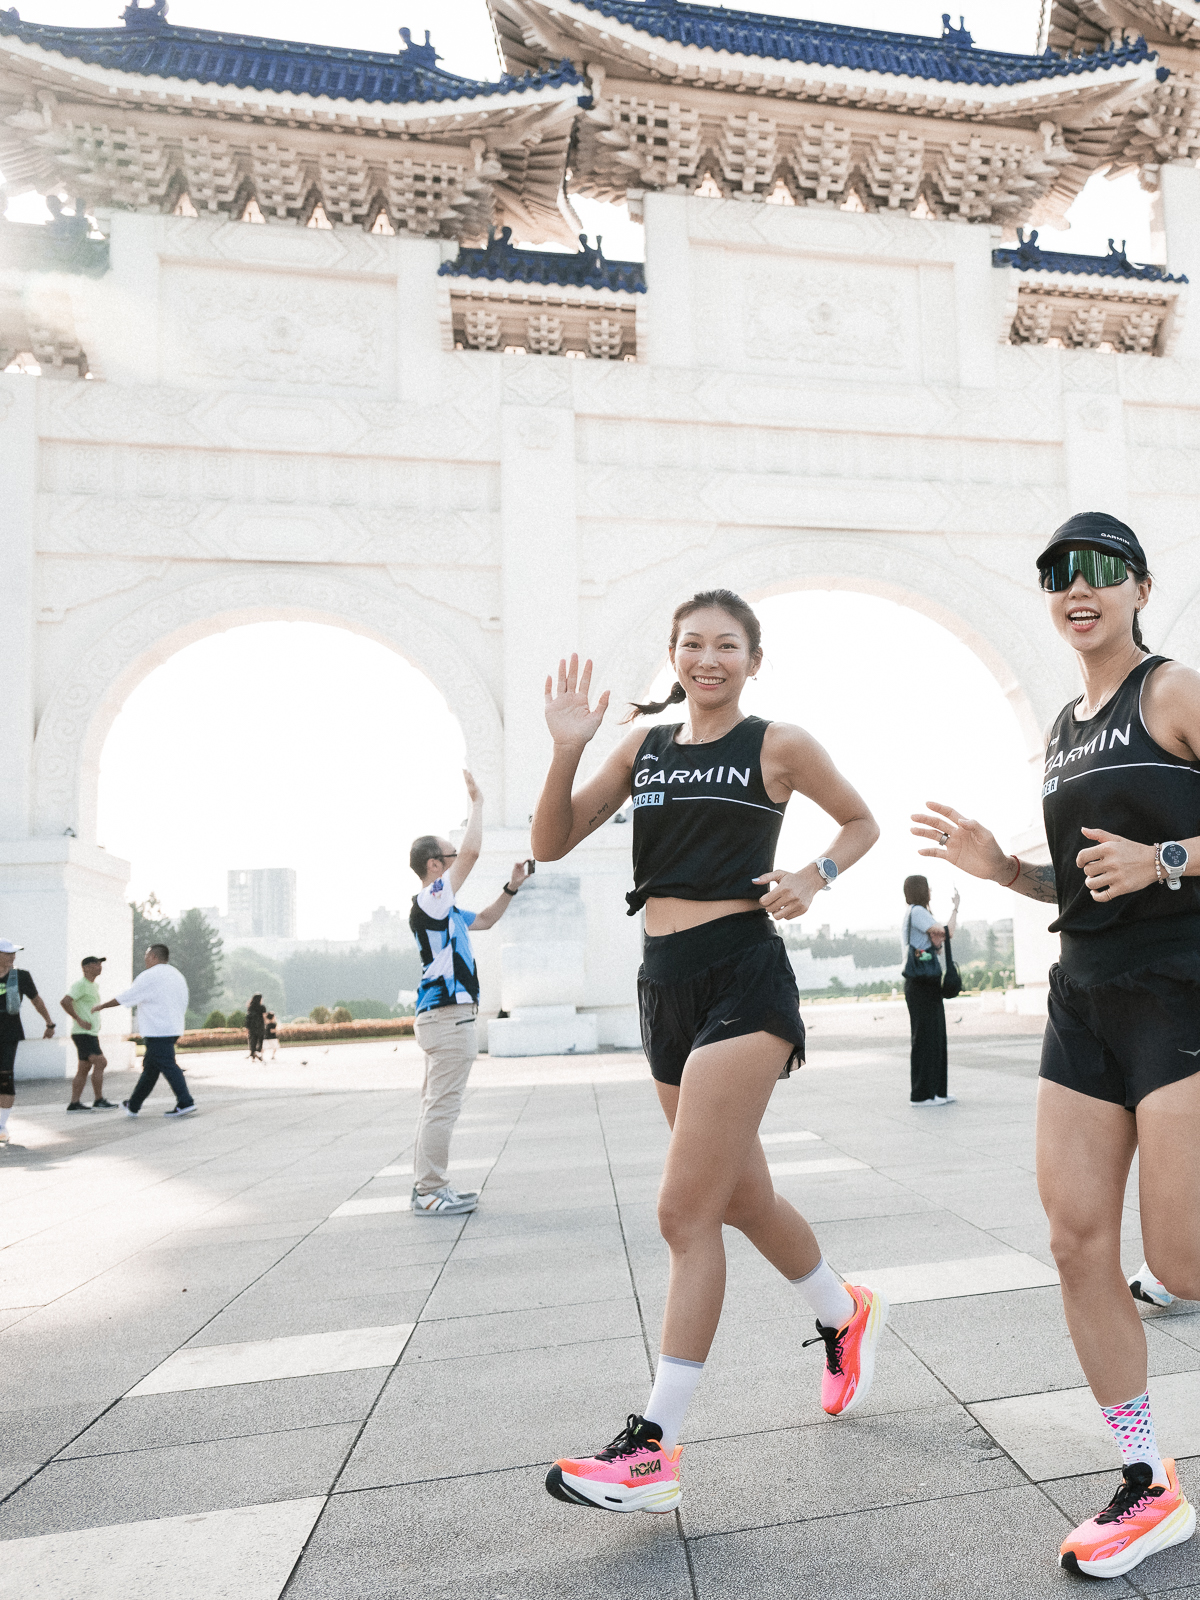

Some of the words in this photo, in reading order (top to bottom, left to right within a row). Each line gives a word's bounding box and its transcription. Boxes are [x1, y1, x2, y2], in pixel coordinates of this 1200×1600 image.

[1100, 532, 1130, 546] GARMIN
[634, 765, 751, 788] GARMIN
[629, 1458, 662, 1479] HOKA
